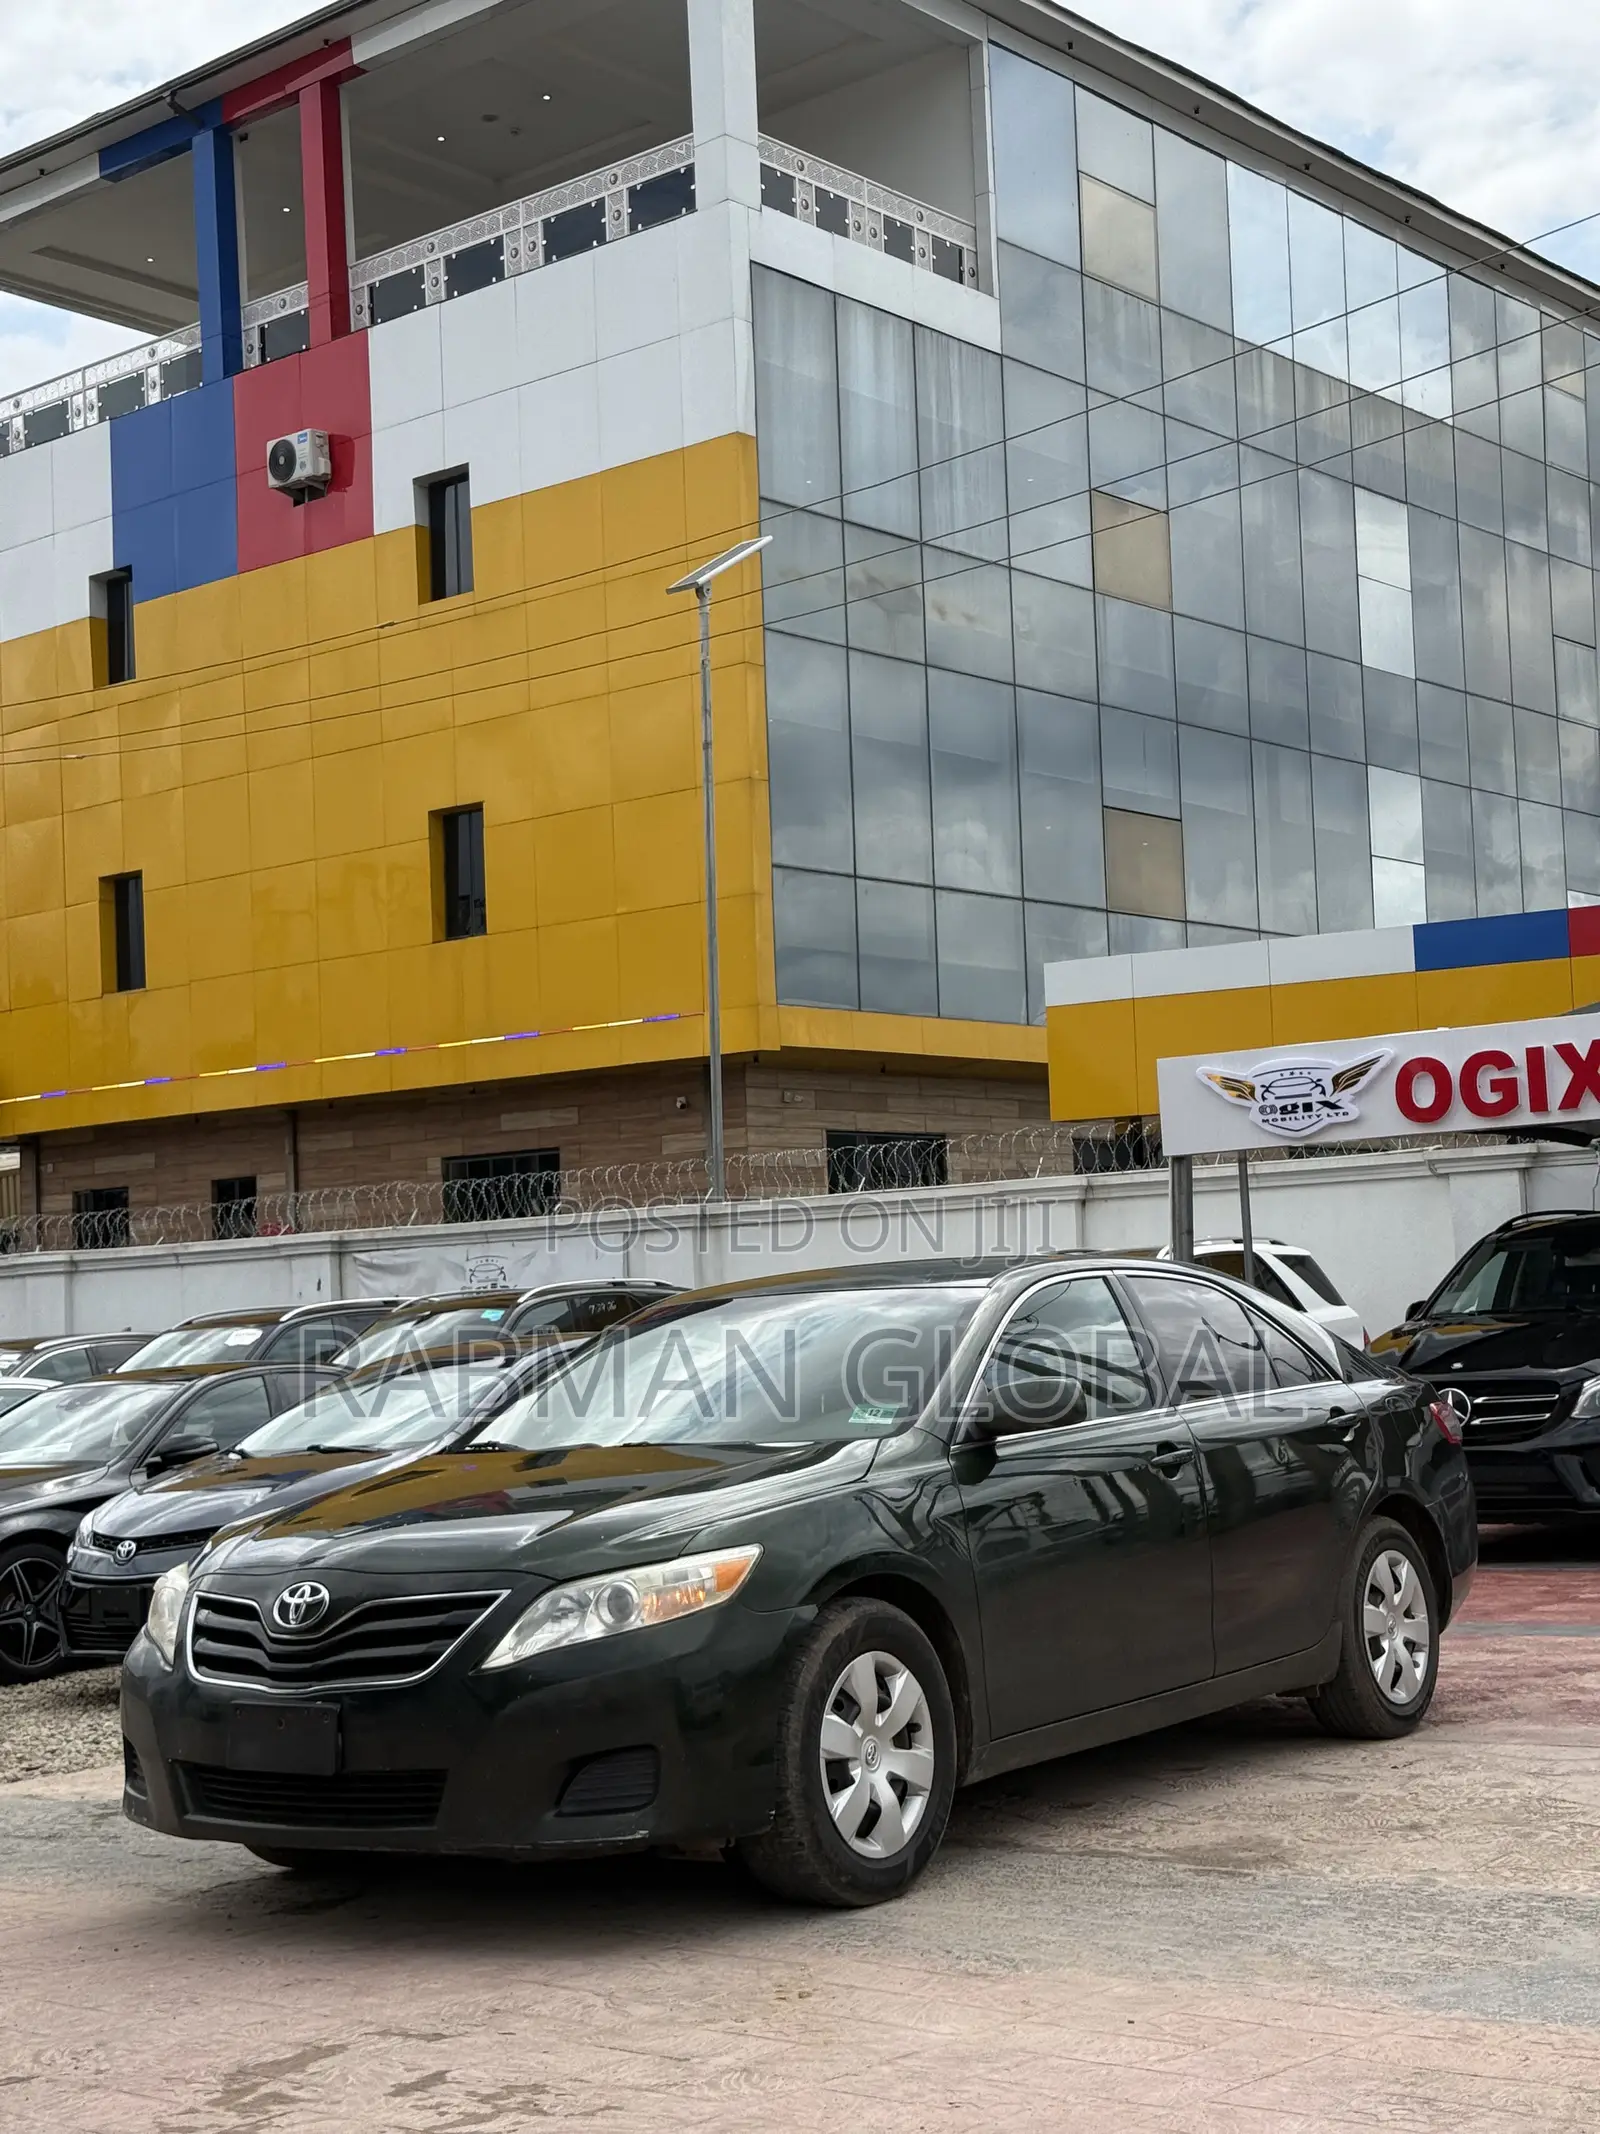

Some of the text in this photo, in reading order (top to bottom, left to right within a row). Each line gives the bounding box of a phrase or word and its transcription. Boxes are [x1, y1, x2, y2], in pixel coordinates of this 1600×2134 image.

[1395, 1037, 1600, 1124] OGIX
[1260, 1110, 1350, 1124] MOBILITY LTD
